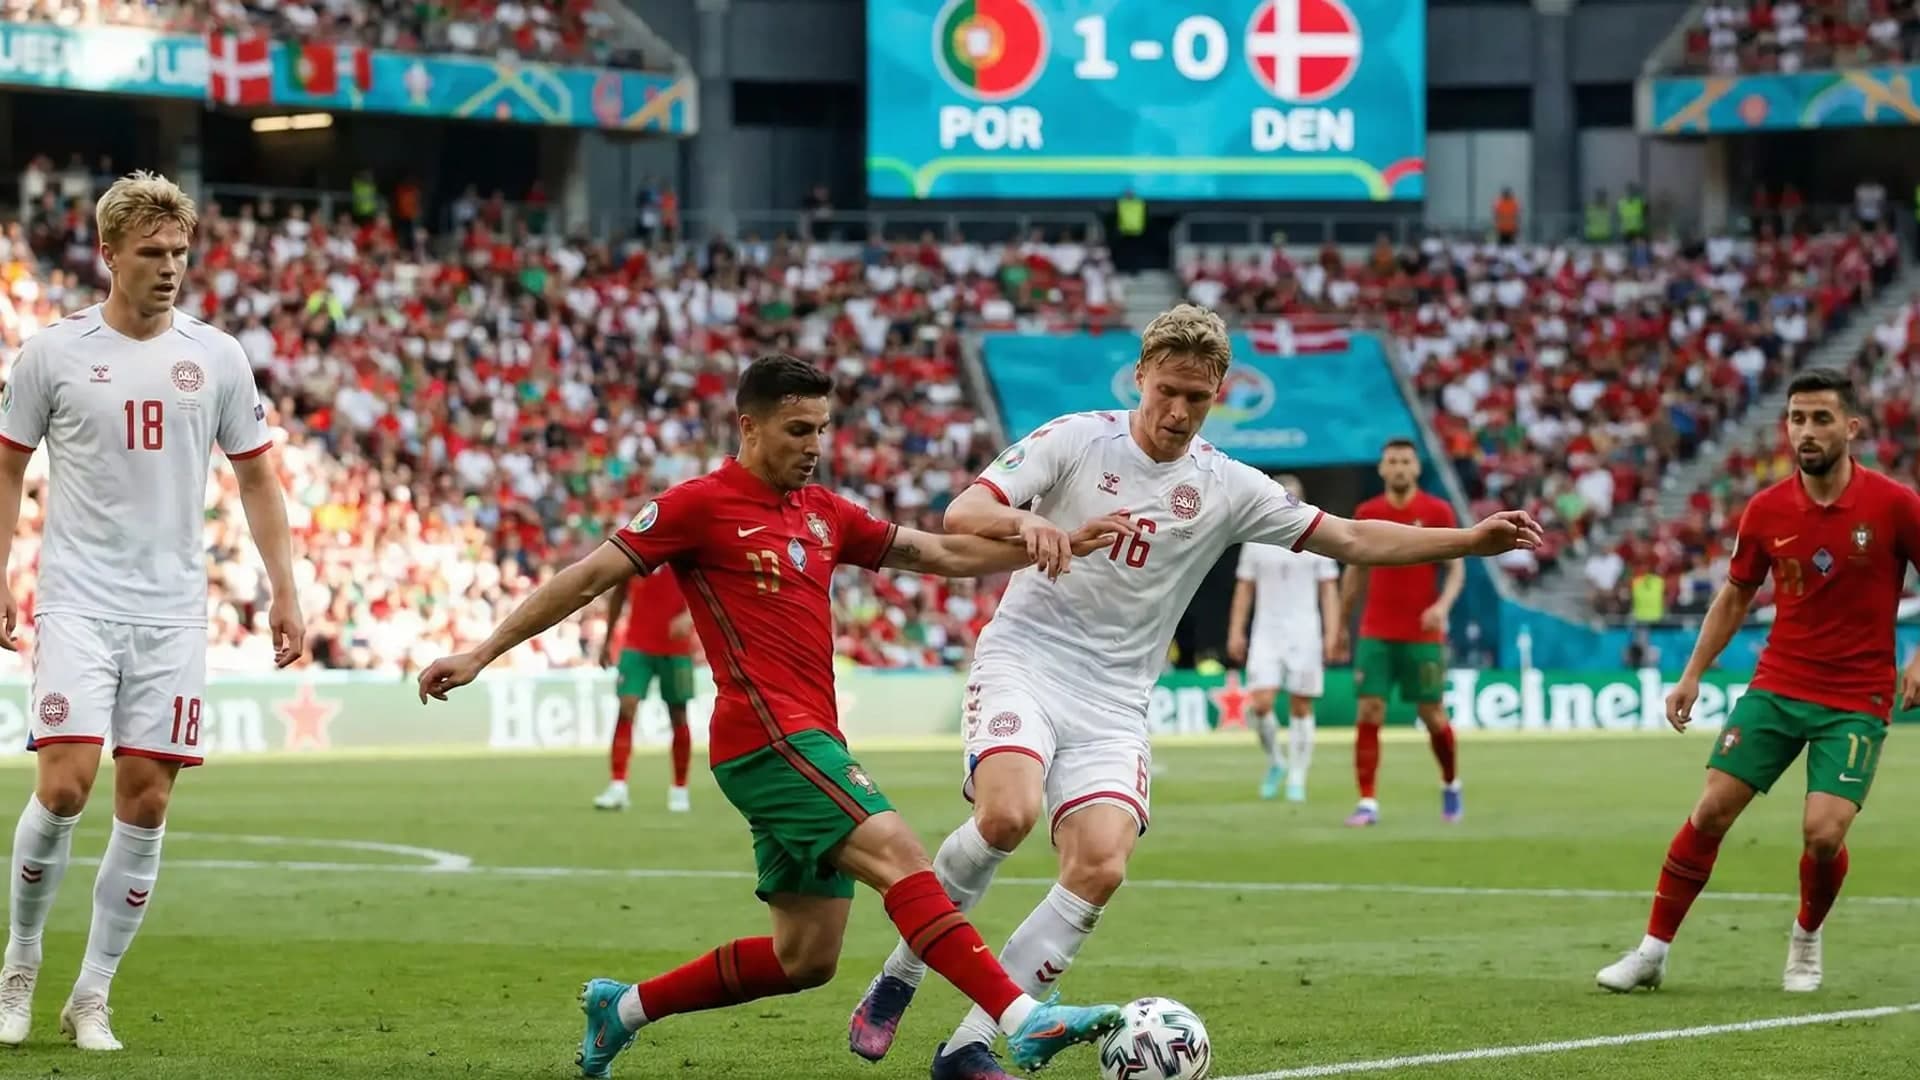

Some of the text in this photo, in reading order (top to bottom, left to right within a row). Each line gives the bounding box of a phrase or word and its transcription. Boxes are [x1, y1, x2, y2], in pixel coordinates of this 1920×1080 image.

[939, 105, 1043, 150] POR
[1251, 107, 1355, 152] DEN
[124, 399, 163, 450] 18
[1108, 509, 1157, 568] 16
[170, 696, 201, 746] 18
[1438, 666, 1750, 730] Heineke
